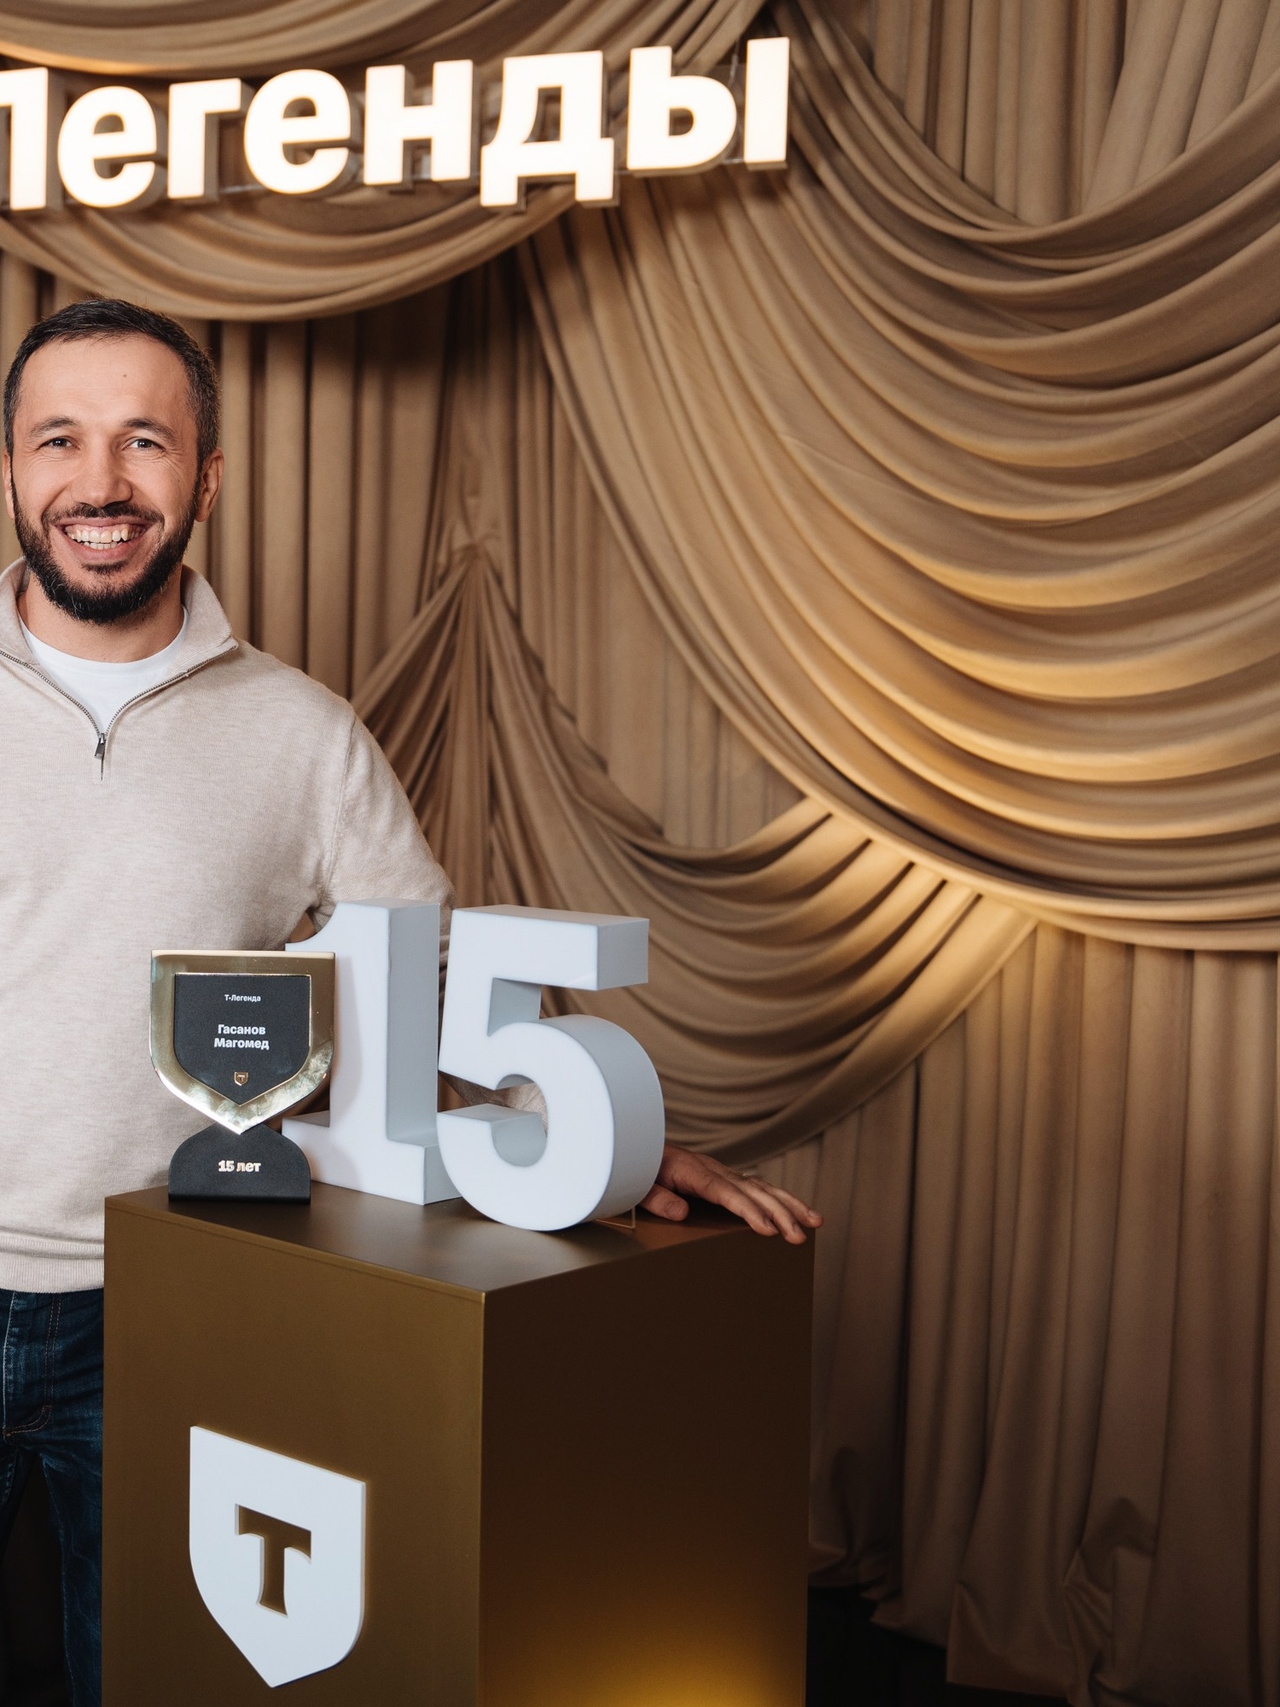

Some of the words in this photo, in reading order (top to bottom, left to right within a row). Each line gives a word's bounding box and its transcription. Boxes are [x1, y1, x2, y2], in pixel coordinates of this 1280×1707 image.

[224, 994, 261, 1002] Т-Легенда
[218, 1024, 266, 1035] Гасанов
[214, 1037, 269, 1050] Магомед
[282, 900, 665, 1231] 15
[218, 1160, 235, 1172] 15
[236, 1161, 261, 1172] лет
